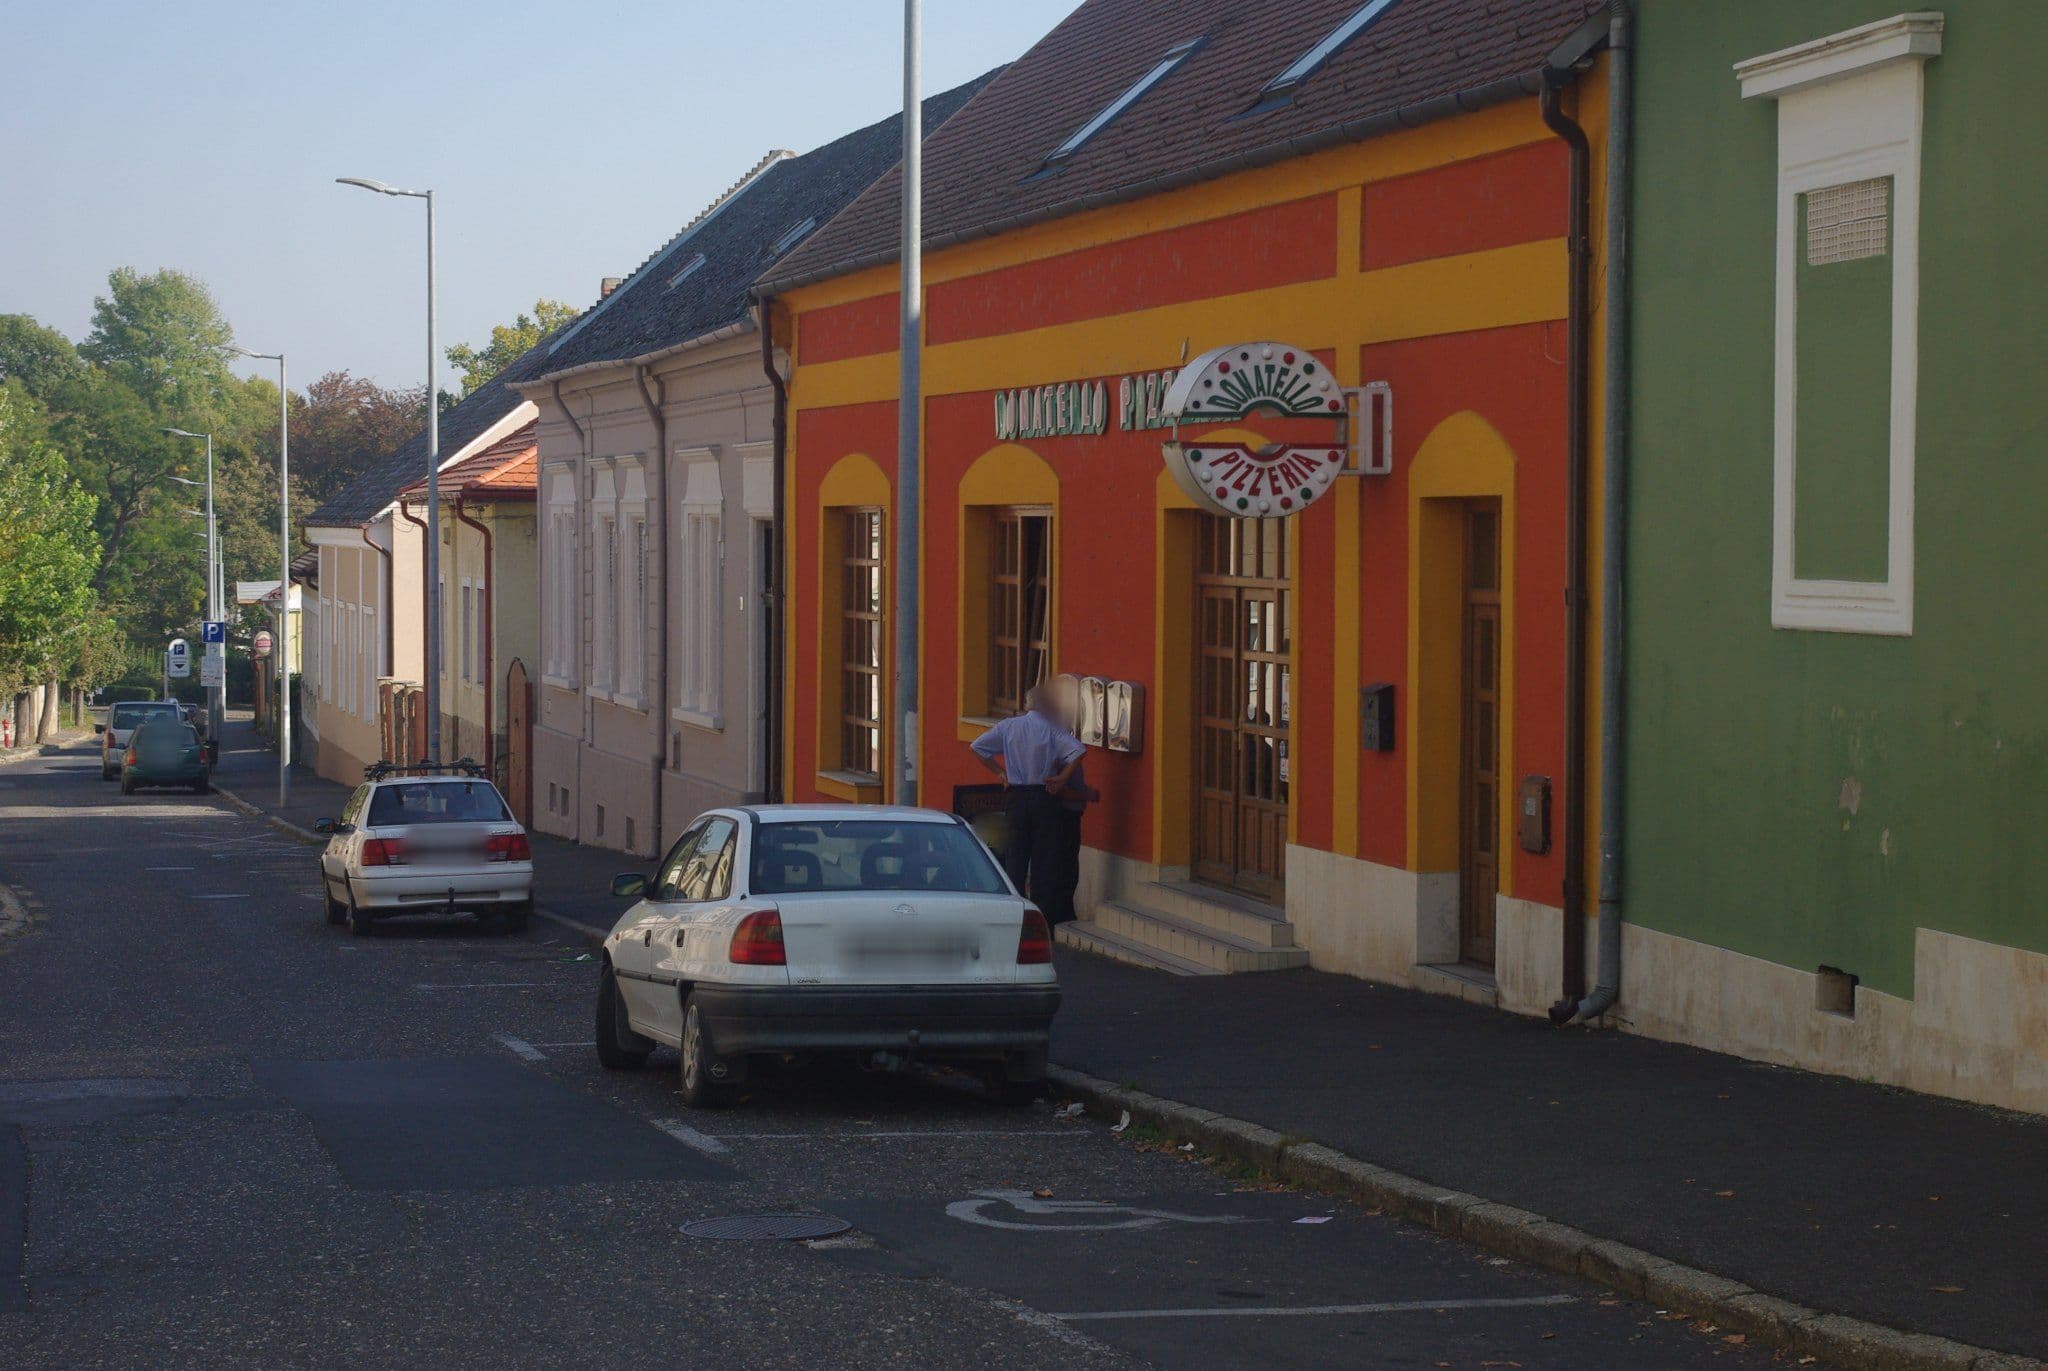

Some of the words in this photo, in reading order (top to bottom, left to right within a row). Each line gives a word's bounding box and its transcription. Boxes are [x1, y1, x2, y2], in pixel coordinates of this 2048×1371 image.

[994, 380, 1108, 440] DONATELLO
[1206, 364, 1324, 412] DONATELLO
[1208, 450, 1323, 497] PIZZERIA
[207, 623, 219, 641] P
